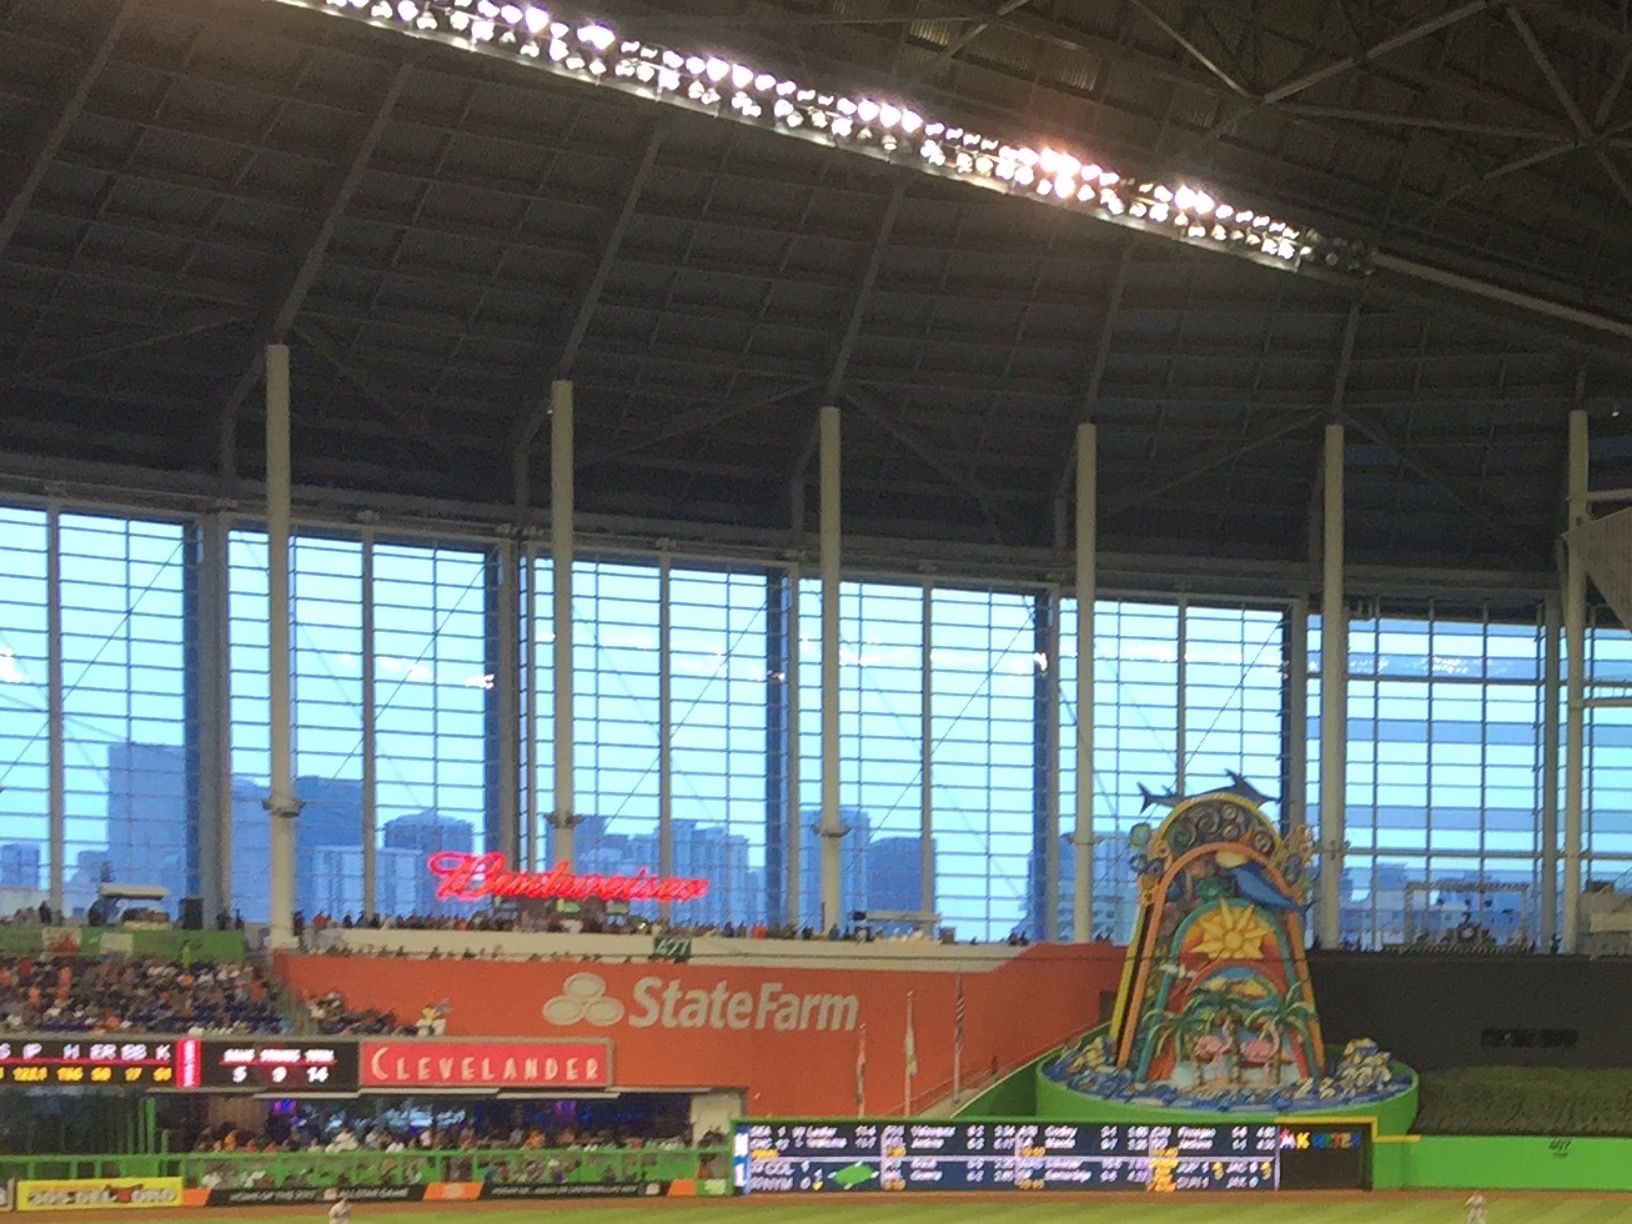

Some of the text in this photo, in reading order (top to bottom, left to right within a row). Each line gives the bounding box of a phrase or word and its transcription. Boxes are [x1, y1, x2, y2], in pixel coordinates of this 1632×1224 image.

[427, 851, 711, 902] Budweiser
[155, 1044, 171, 1060] K
[371, 1046, 599, 1081] CLEVELANDER
[233, 1067, 329, 1083] 5 9 14
